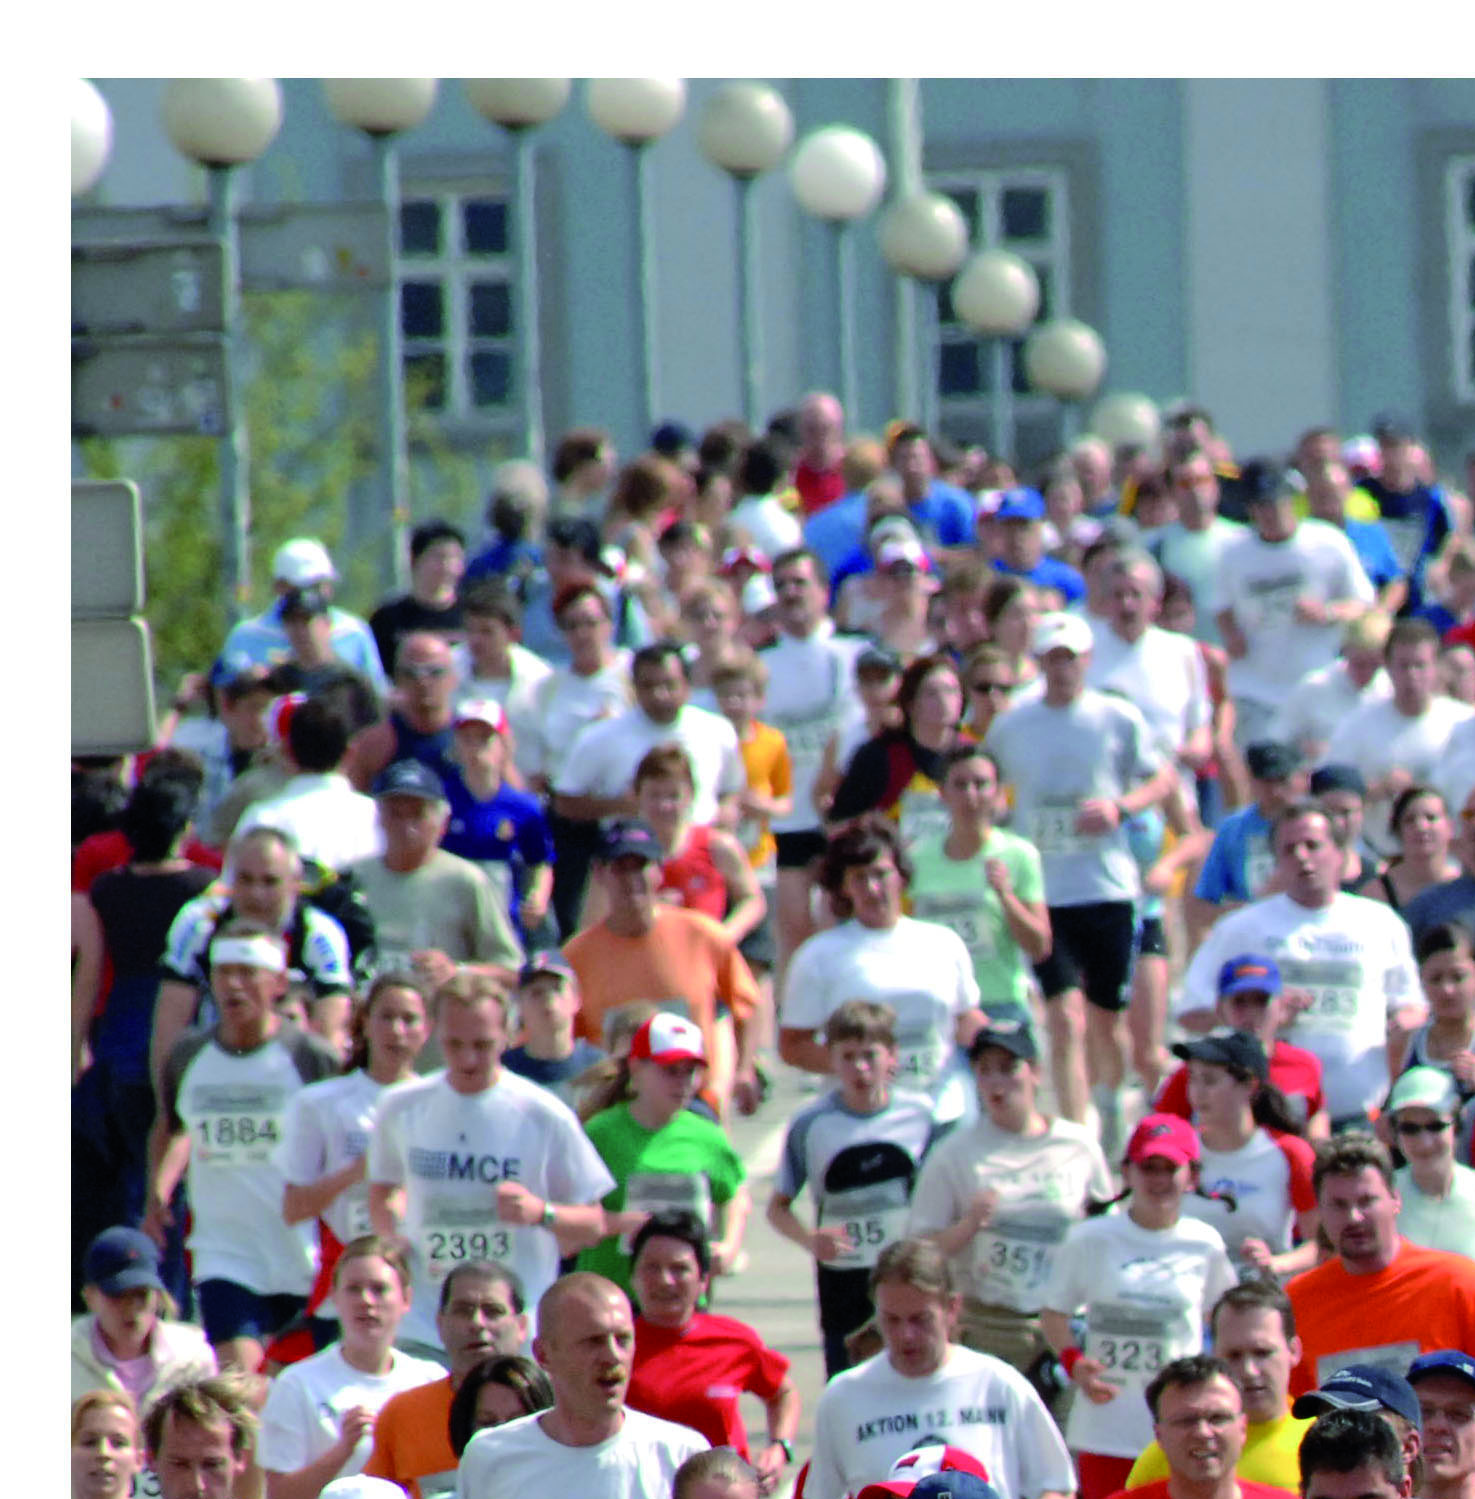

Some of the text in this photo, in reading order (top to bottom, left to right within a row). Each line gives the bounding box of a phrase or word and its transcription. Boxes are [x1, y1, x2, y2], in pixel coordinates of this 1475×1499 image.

[196, 1117, 278, 1145] 1884
[427, 1231, 511, 1262] 2393
[1098, 1339, 1162, 1372] 323
[855, 1412, 918, 1444] AKTION
